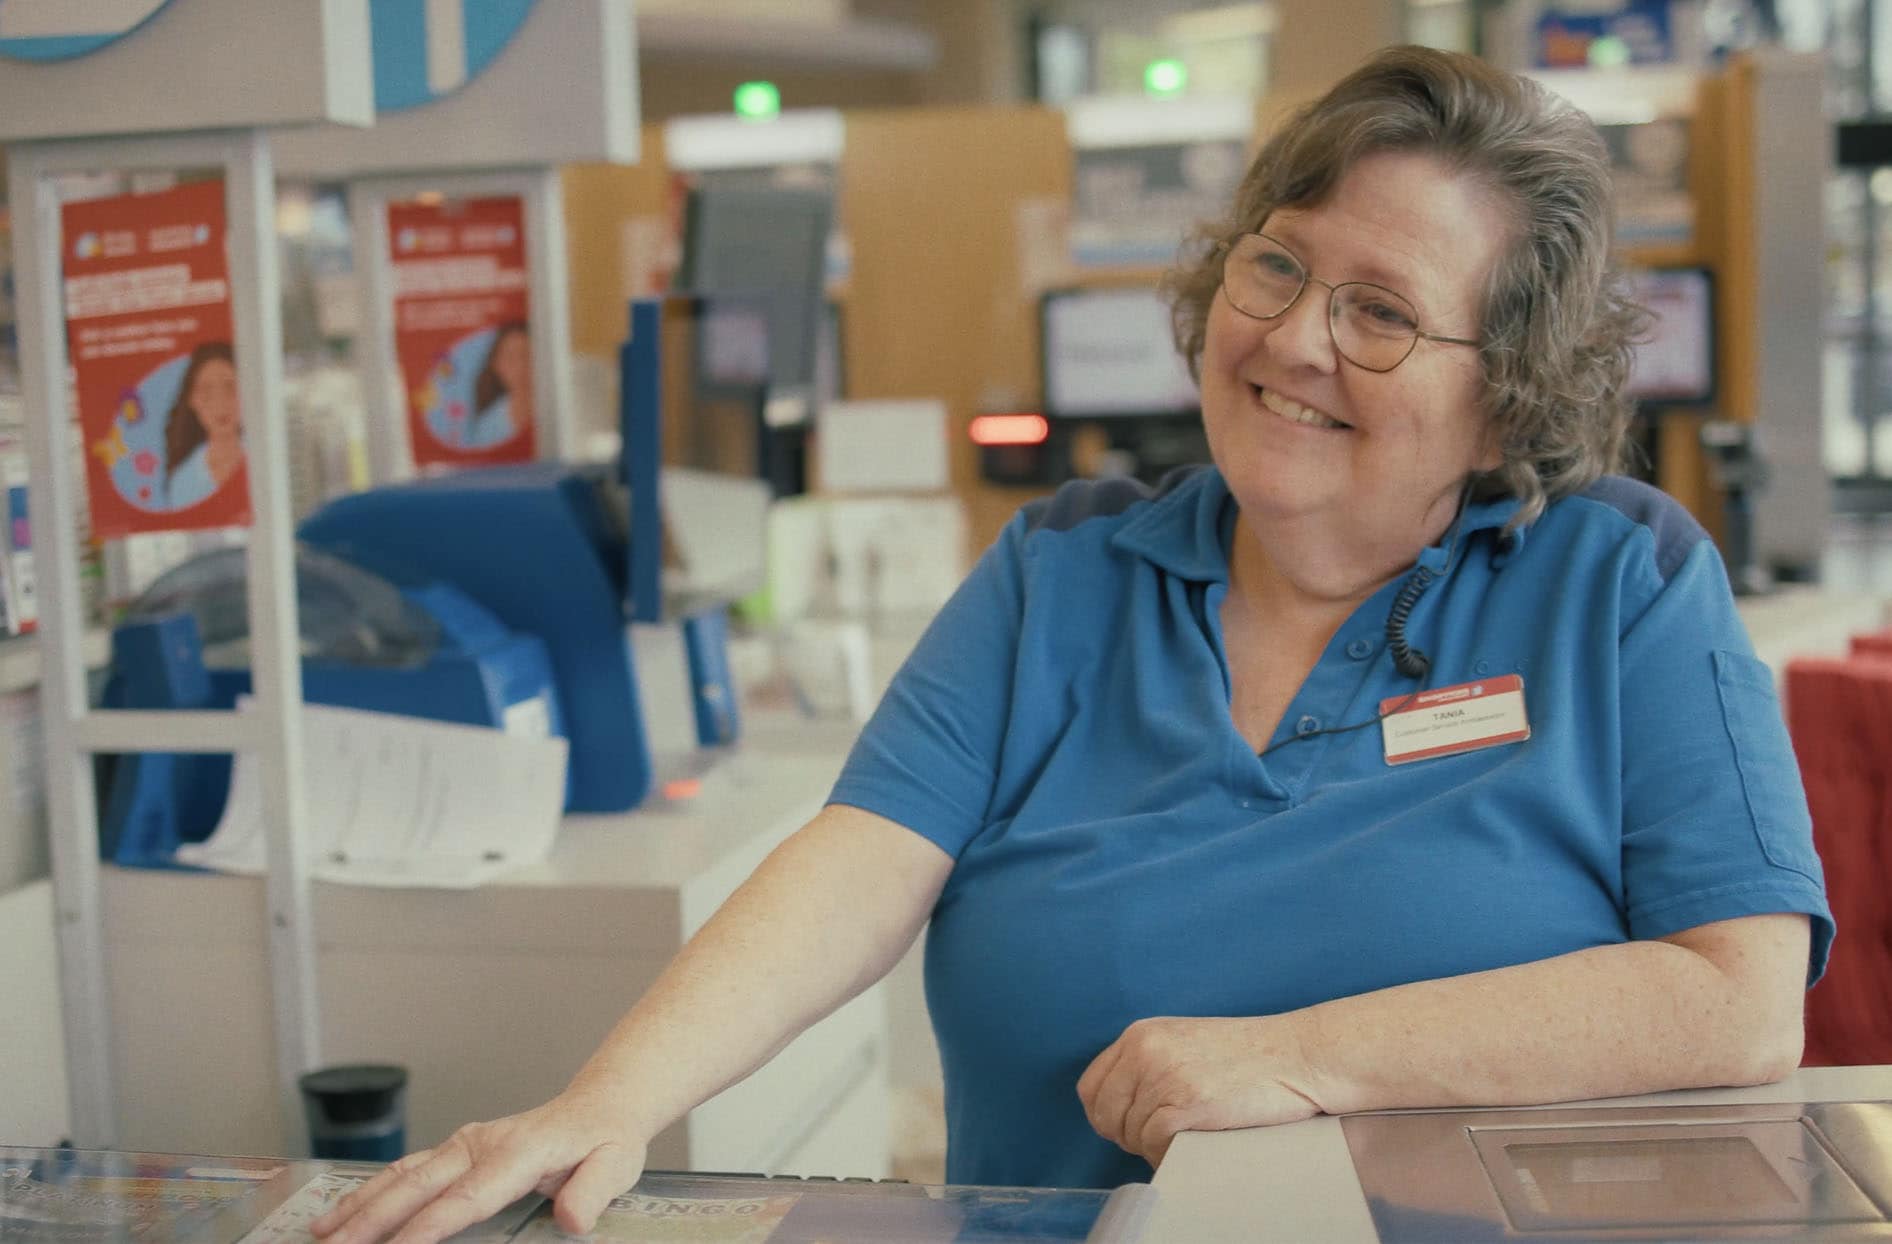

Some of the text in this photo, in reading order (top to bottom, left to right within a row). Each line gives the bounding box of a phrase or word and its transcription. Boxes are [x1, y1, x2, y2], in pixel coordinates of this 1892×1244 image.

[1433, 708, 1465, 721] TANIA
[1395, 725, 1432, 737] Customer
[1432, 719, 1459, 731] Service
[607, 1197, 762, 1217] BINGO
